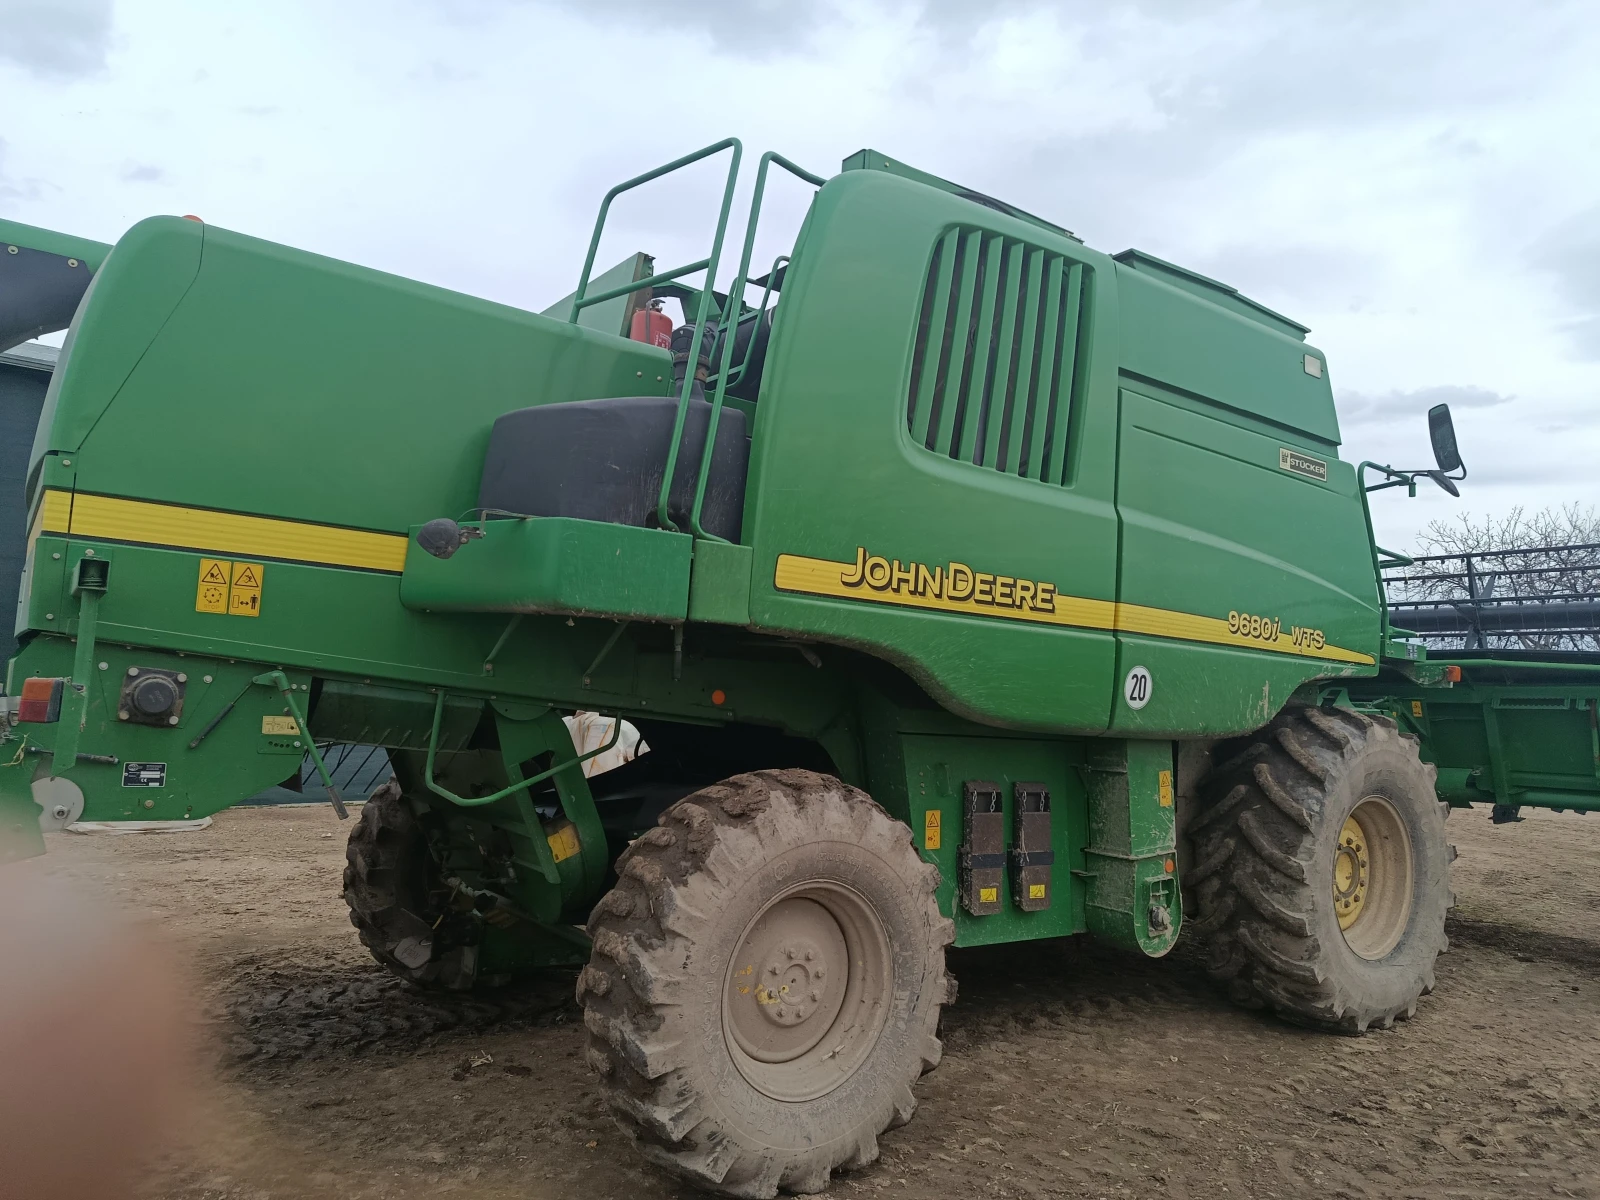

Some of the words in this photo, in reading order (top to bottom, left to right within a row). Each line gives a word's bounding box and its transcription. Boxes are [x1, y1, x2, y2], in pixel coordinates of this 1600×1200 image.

[1290, 457, 1325, 475] STÜCKER
[840, 546, 945, 600] JOHN
[946, 560, 1058, 614] DEERE
[1228, 610, 1281, 642] 9680i
[1291, 625, 1326, 650] WTS
[1129, 673, 1148, 702] 20
